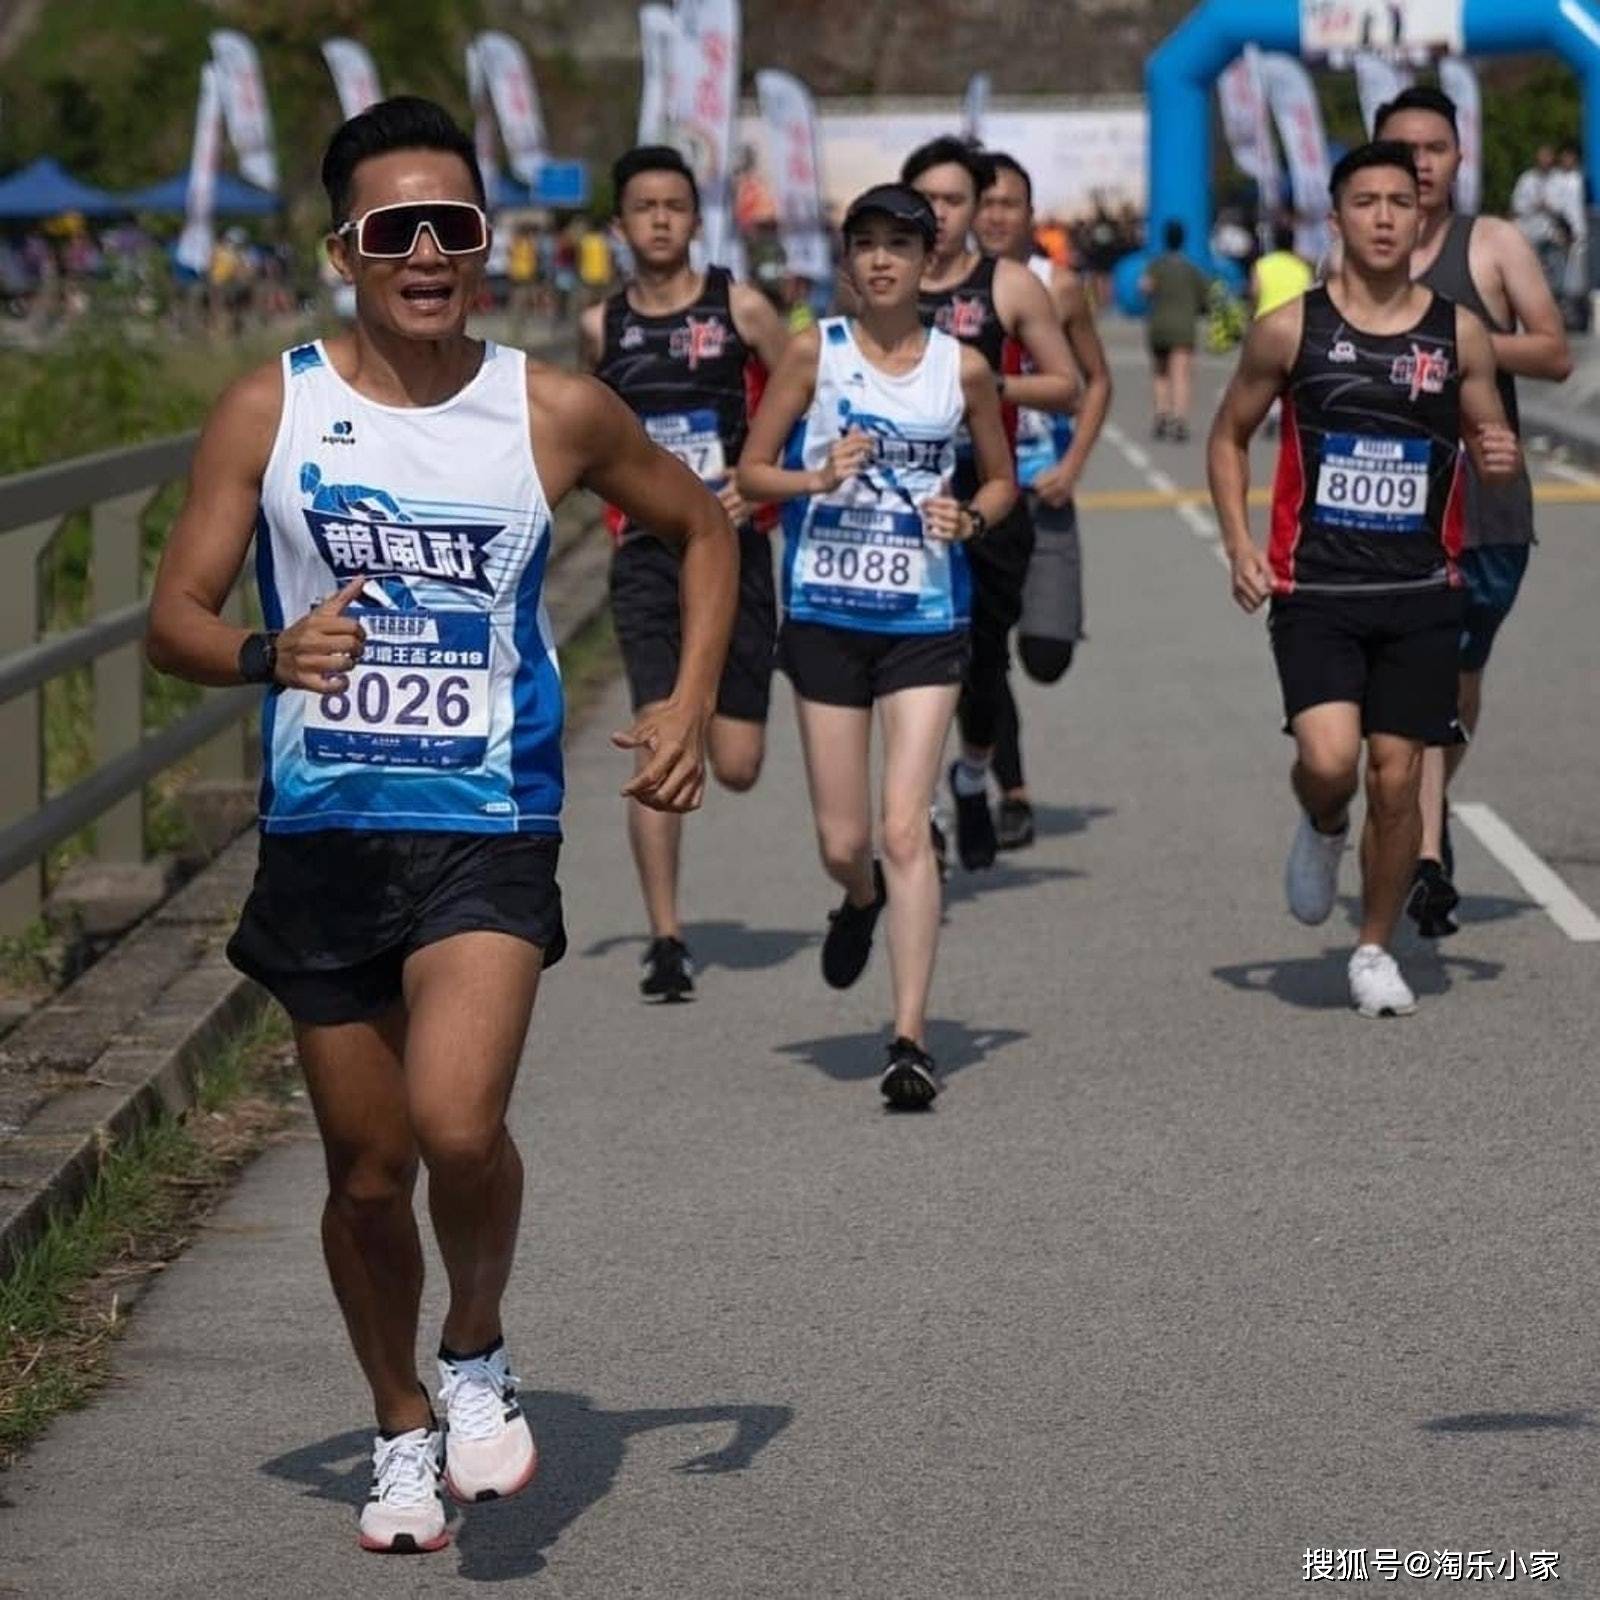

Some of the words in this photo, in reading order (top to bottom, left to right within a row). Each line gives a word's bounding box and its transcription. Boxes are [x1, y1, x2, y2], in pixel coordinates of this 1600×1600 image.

[1328, 472, 1417, 508] 8009
[321, 522, 476, 579] 競風社
[814, 545, 910, 586] 8088
[320, 672, 470, 727] 8026
